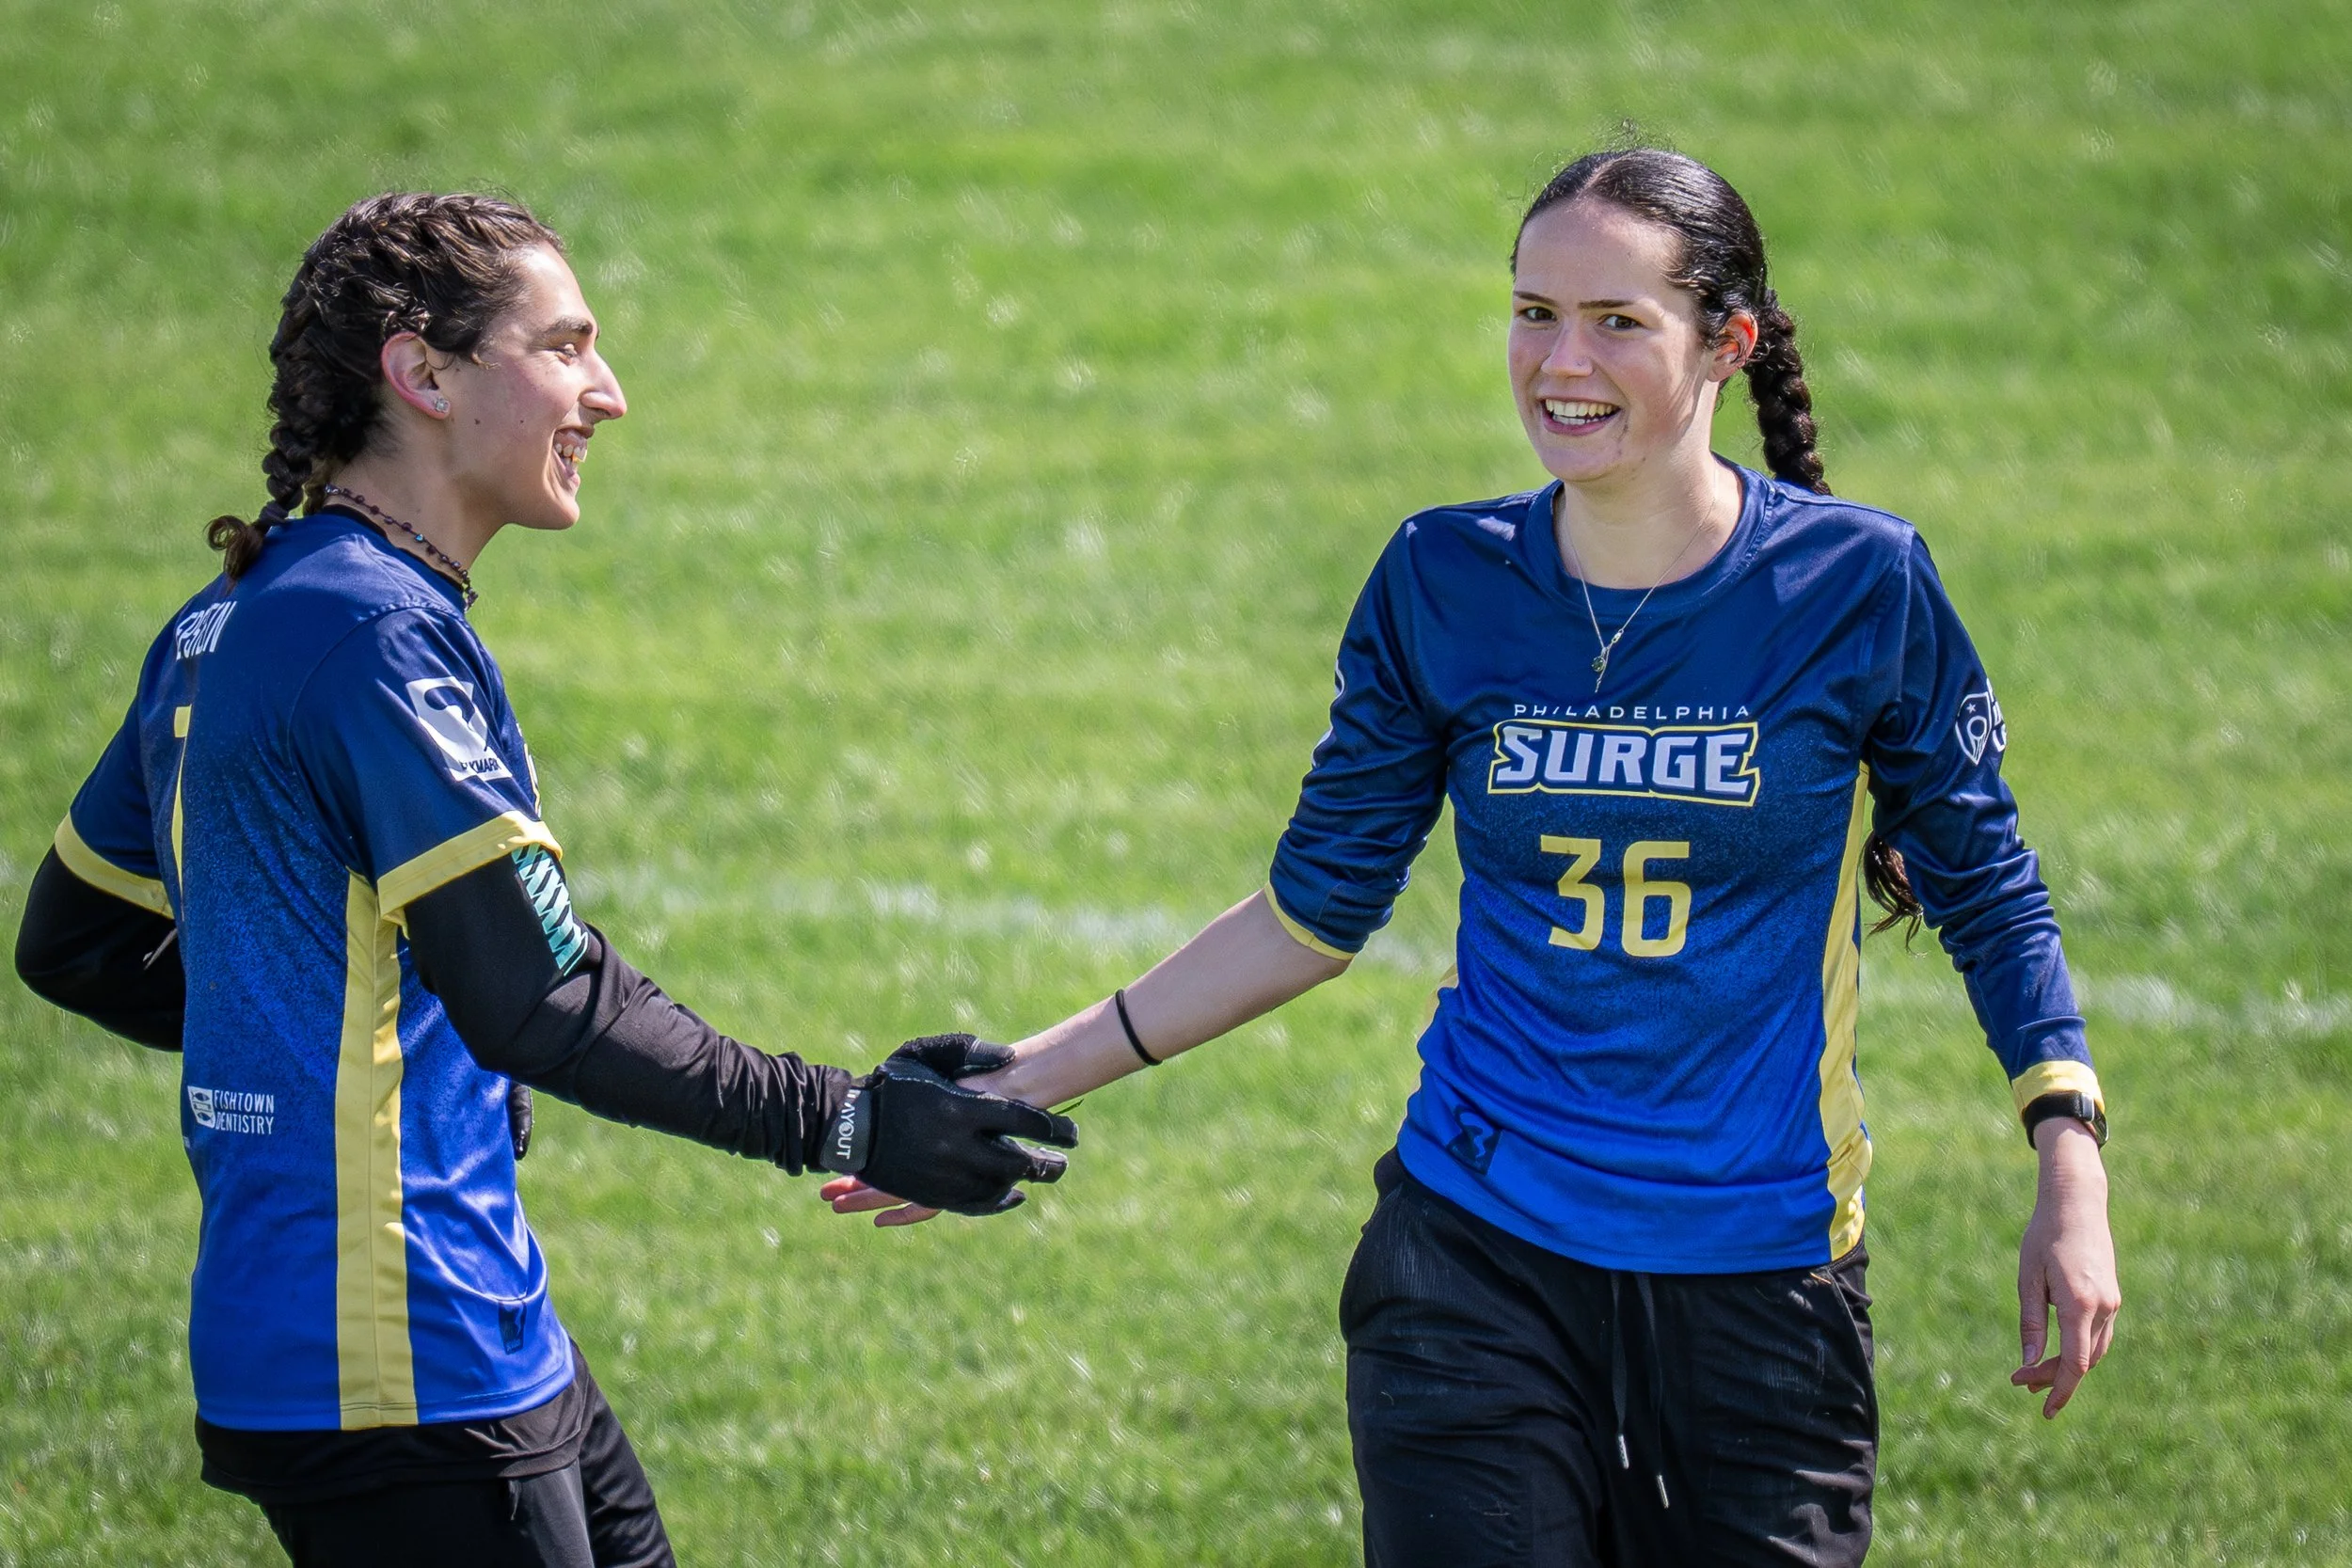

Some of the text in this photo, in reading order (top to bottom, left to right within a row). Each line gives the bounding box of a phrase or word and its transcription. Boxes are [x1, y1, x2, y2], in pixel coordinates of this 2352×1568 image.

[1514, 704, 1750, 720] PHILADELPHIA
[1496, 725, 1750, 795] SURGE
[1539, 833, 1692, 958] 36
[214, 1089, 275, 1114] FISHTOWN
[215, 1111, 275, 1135] DENTISTRY
